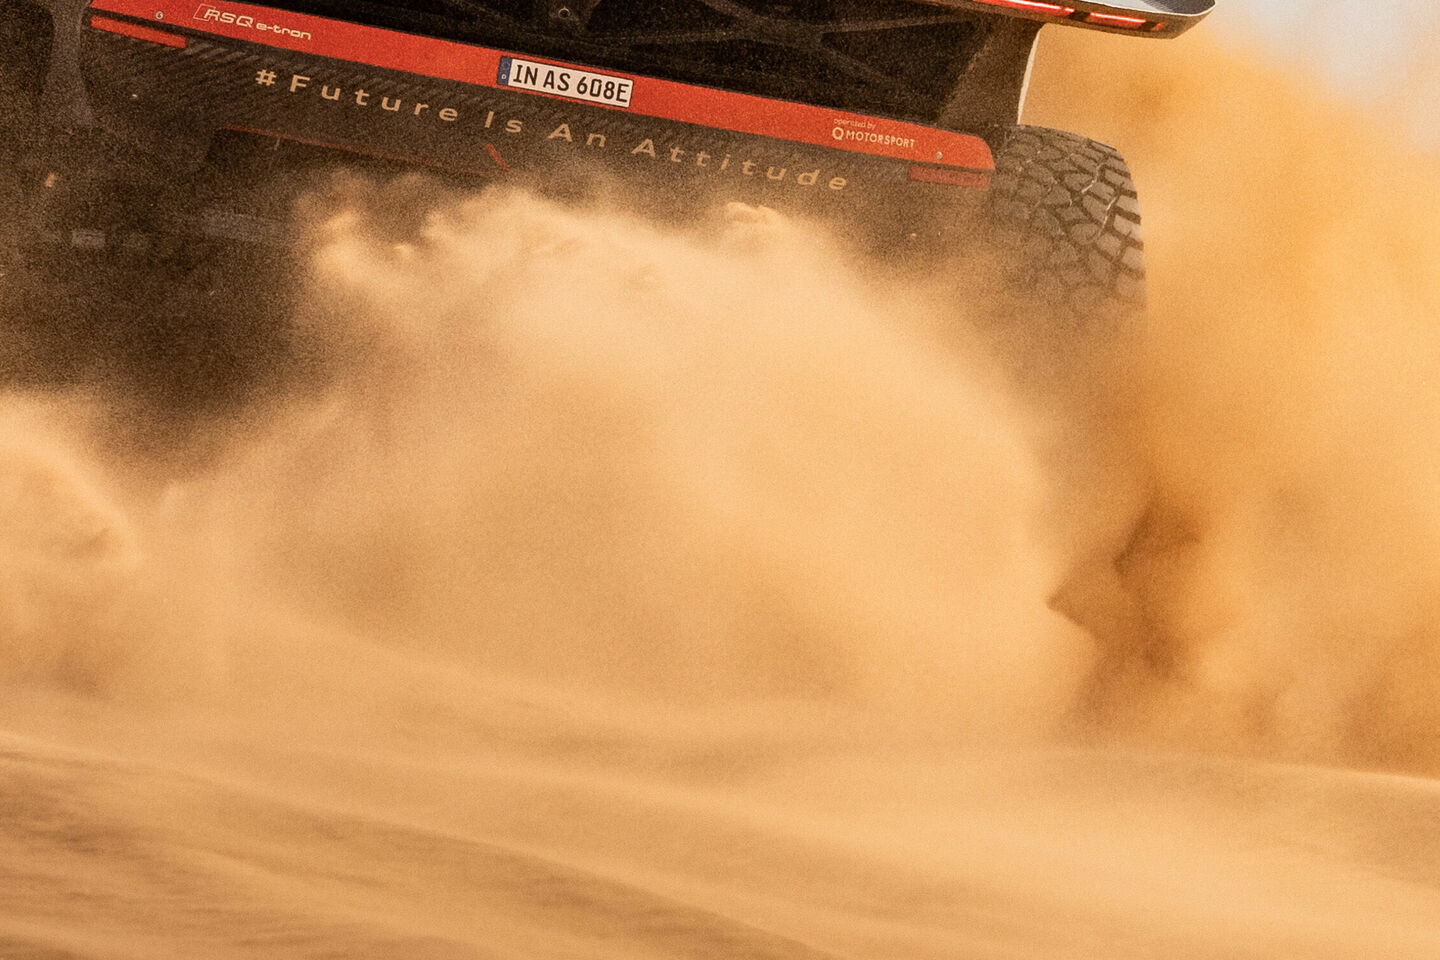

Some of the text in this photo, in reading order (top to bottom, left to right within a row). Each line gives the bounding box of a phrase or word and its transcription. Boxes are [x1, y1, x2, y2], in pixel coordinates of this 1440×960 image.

[200, 7, 311, 40] RSQ e-tron
[513, 64, 629, 103] IN AS 608E
[255, 69, 848, 191] #Future Is An Attitude
[846, 129, 916, 148] MOTORSPORT
[866, 121, 877, 131] by
